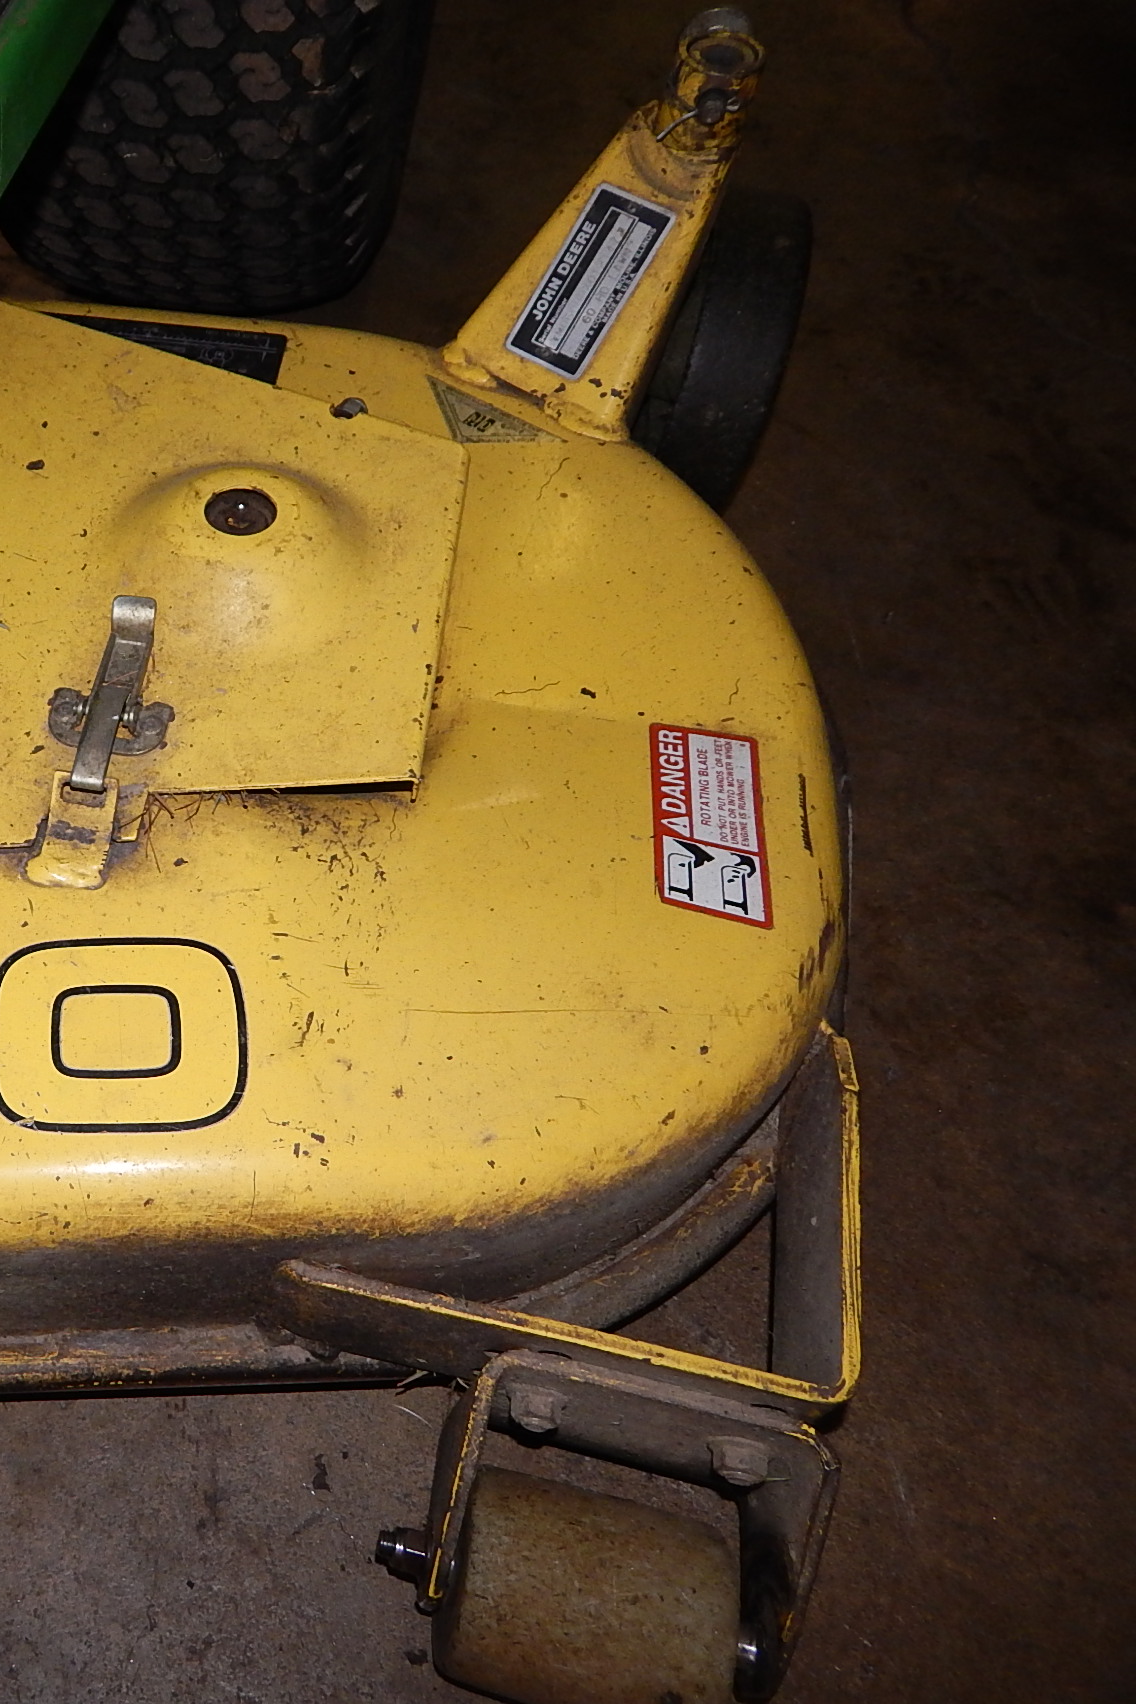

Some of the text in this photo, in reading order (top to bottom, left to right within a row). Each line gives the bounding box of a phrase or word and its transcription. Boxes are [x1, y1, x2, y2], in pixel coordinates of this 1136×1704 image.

[532, 277, 563, 321] JOHN
[556, 220, 596, 276] DEERE
[581, 306, 596, 325] 60
[658, 729, 685, 813] DANGER
[697, 747, 710, 826] ROTATING BLADE
[714, 739, 728, 842] DO NOT PUT HANDS OR FEET
[725, 761, 734, 787] MOWER
[727, 788, 735, 806] INTO
[728, 807, 736, 818] OR
[737, 778, 749, 846] ENGINE IS RUNNING
[730, 820, 738, 844] UNDER
